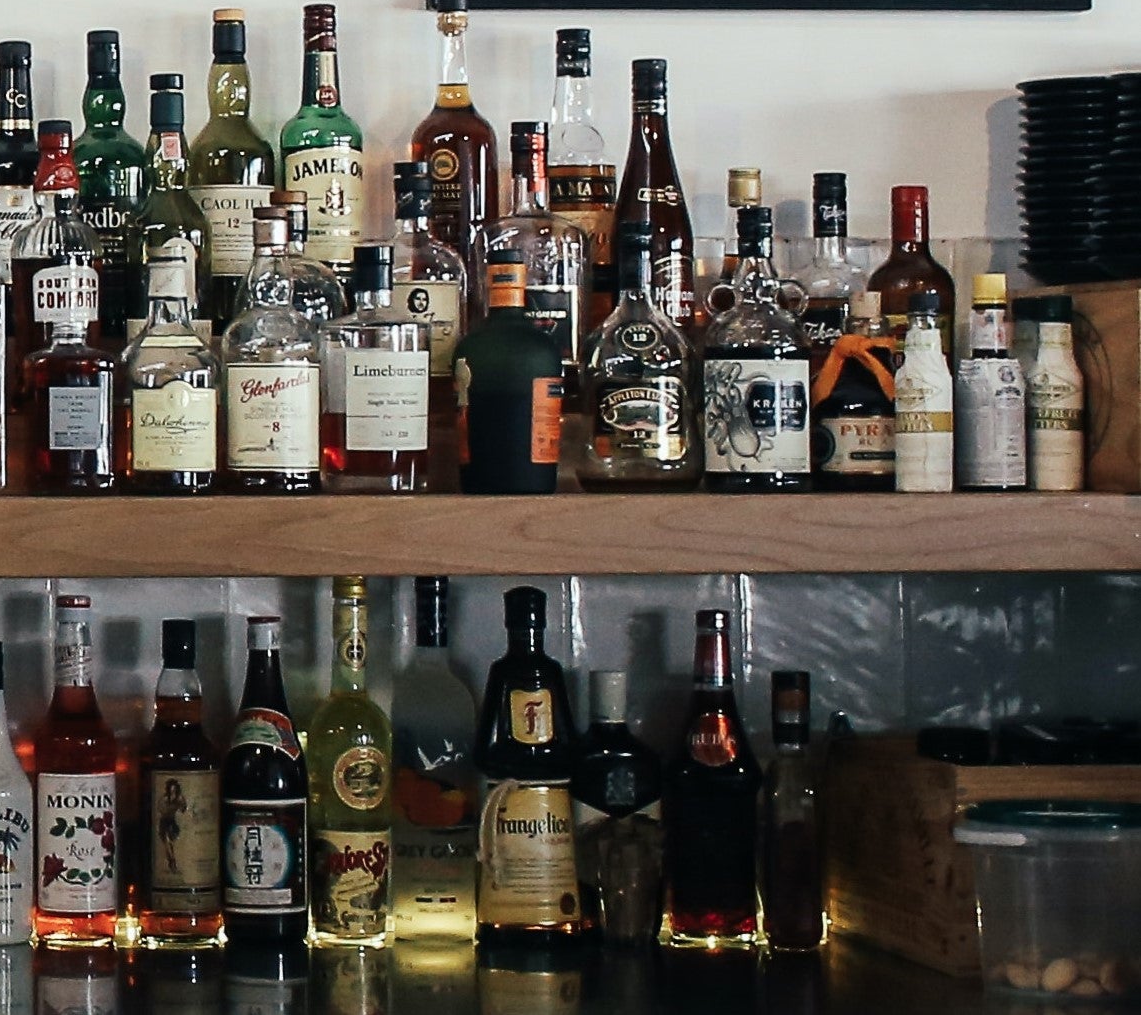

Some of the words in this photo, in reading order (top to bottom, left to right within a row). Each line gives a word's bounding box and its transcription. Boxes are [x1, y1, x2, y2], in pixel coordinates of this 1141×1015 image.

[293, 158, 363, 181] JAMEON
[200, 197, 240, 210] CAOL
[227, 218, 240, 229] 12
[272, 422, 280, 432] 8
[47, 795, 113, 809] MONIN
